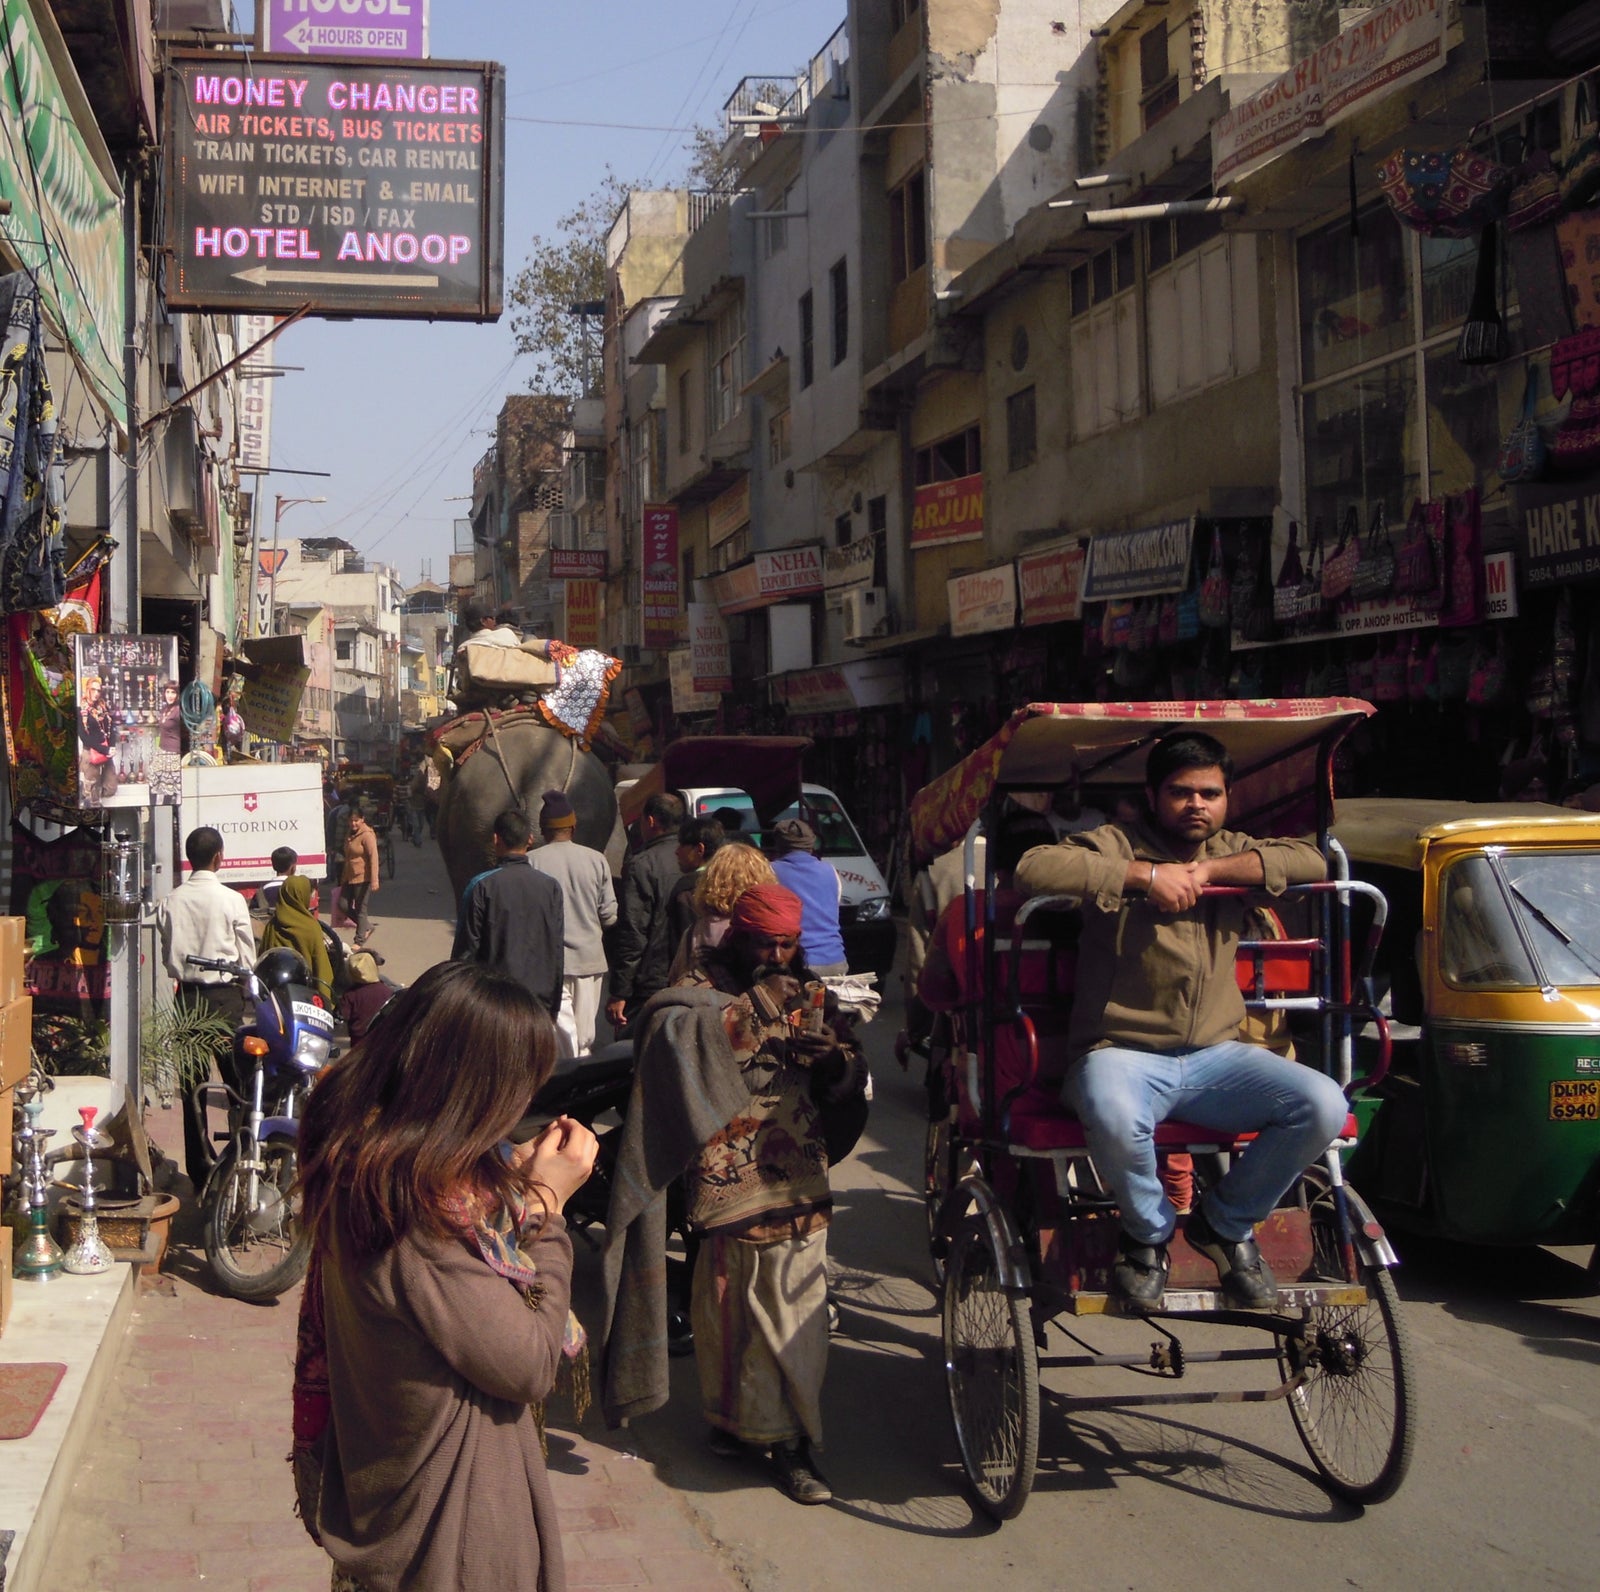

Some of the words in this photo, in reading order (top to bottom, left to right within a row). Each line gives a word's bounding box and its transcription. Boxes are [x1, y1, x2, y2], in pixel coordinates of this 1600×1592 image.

[298, 28, 314, 44] 24
[318, 28, 363, 46] HOURS
[367, 29, 404, 46] OPEN
[195, 76, 308, 108] MONEY
[327, 81, 480, 114] CHANGER
[195, 114, 231, 134] AIR
[239, 114, 335, 142] TICKETS,
[343, 119, 383, 140] BUS
[393, 121, 483, 143] TICKETS
[193, 140, 254, 163] TRAIN
[263, 142, 352, 168] TICKETS,
[358, 147, 398, 168] CAR
[406, 150, 480, 170] RENTAL
[198, 174, 244, 195] WIFI
[258, 175, 367, 199] INTERNET
[379, 181, 394, 200] &
[410, 182, 475, 203] EMAIL
[261, 203, 300, 225] STD
[323, 205, 355, 226] ISD
[378, 208, 416, 229] FAX
[195, 227, 320, 259] HOTEL
[337, 231, 472, 264] ANOOP
[912, 492, 984, 531] ARJUN
[1526, 499, 1581, 559] HARE
[1583, 492, 1600, 548] K
[651, 513, 671, 560] MONEY
[553, 552, 577, 564] HARE
[579, 552, 604, 565] RAMA
[771, 551, 818, 573] NEHA
[1556, 560, 1583, 578] MAIN
[644, 580, 677, 592] CHANGER
[761, 573, 791, 591] EXPORT
[793, 570, 823, 586] HOUSE
[567, 581, 598, 609] AJAY
[570, 611, 596, 628] guest
[1345, 617, 1361, 631] OPP.
[1364, 614, 1391, 628] ANOOP
[1393, 611, 1422, 625] HOTEL,
[695, 626, 722, 641] NEHA
[694, 643, 726, 658] EXPORT
[695, 661, 727, 675] HOUSE
[1577, 1058, 1600, 1068] REC
[1553, 1104, 1596, 1117] 6940
